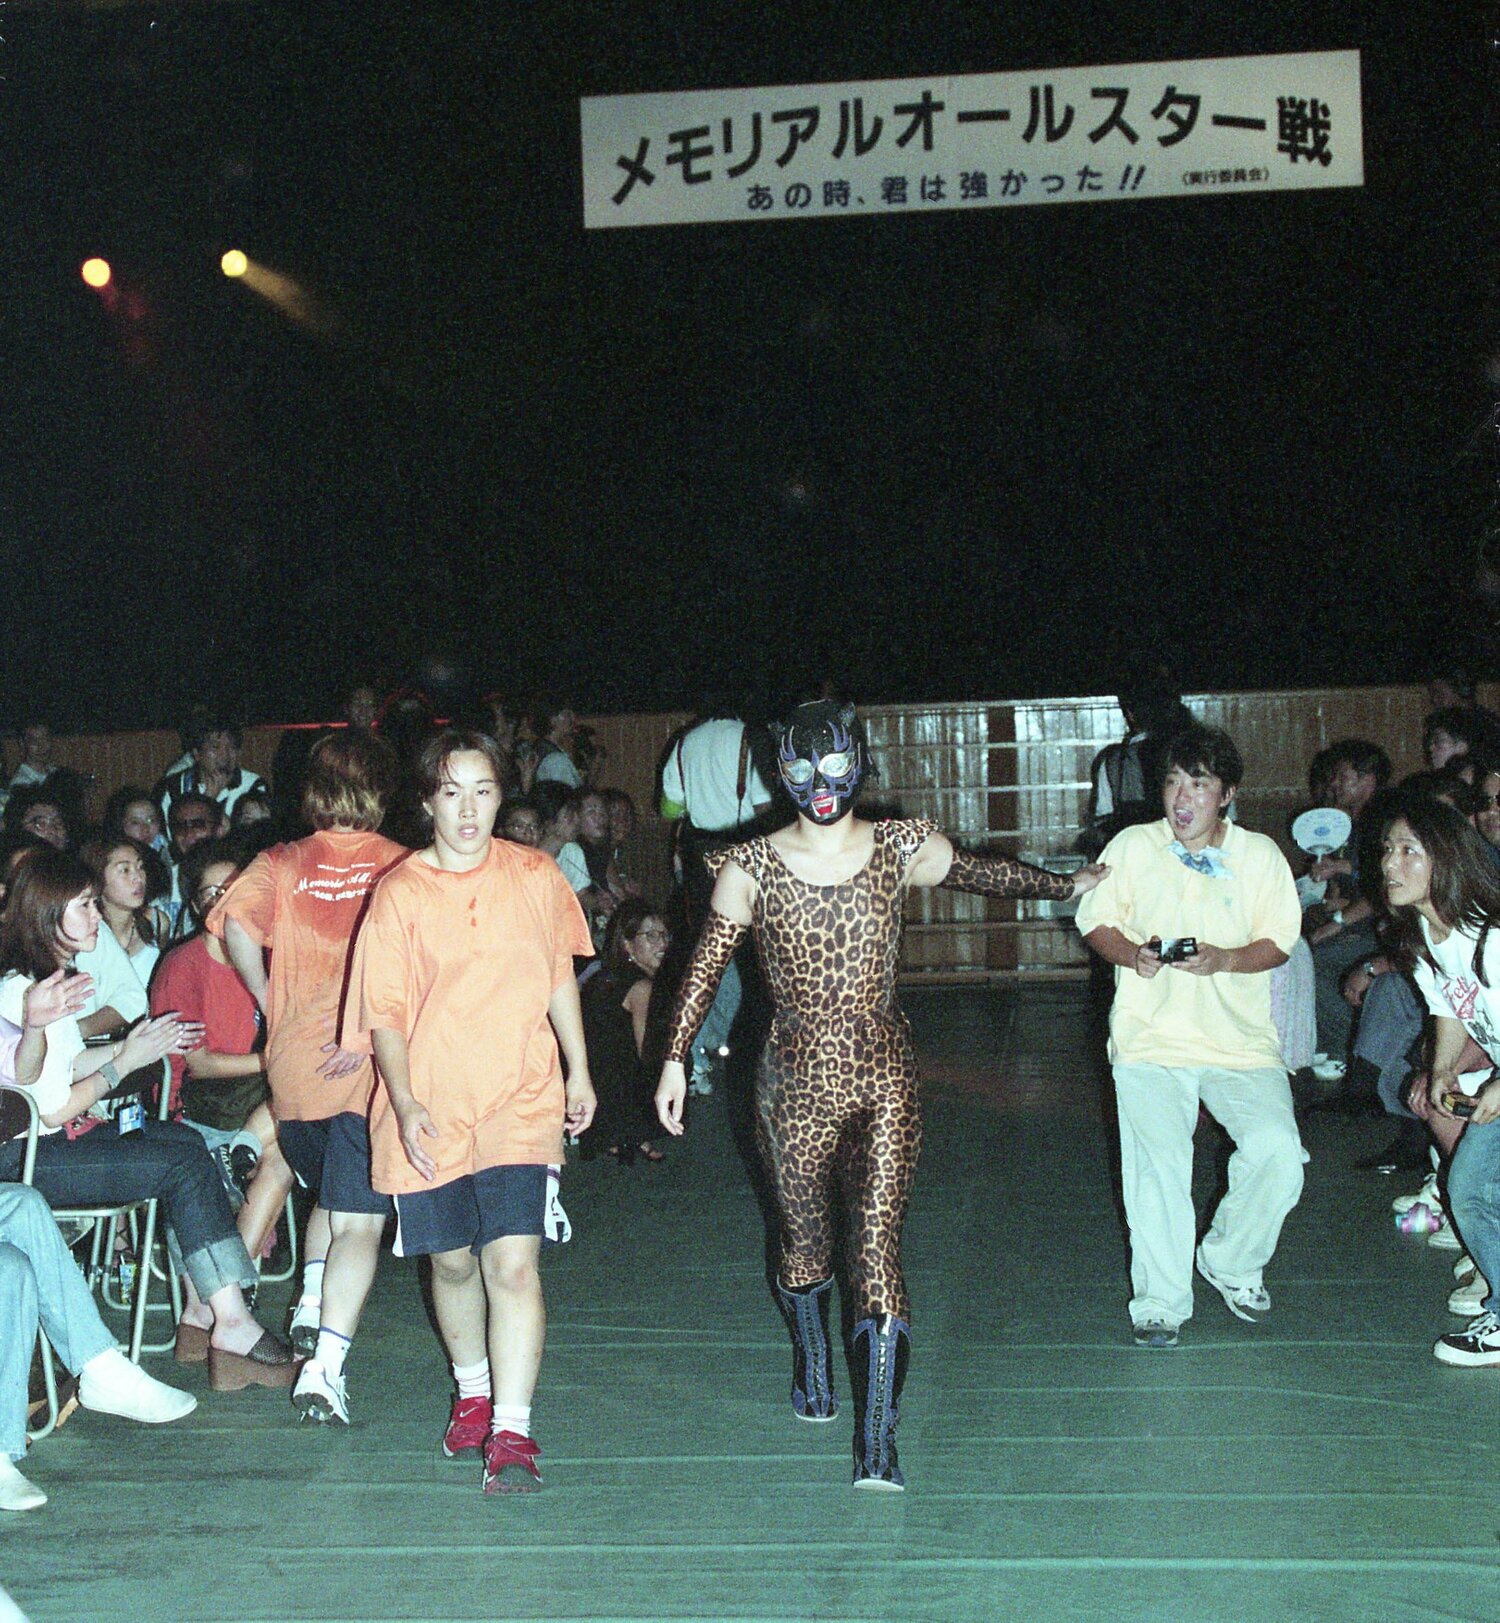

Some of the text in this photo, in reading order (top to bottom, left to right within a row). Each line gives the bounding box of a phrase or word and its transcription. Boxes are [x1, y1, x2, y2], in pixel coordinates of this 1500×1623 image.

[611, 84, 1333, 206] メモリアルオールスター戦
